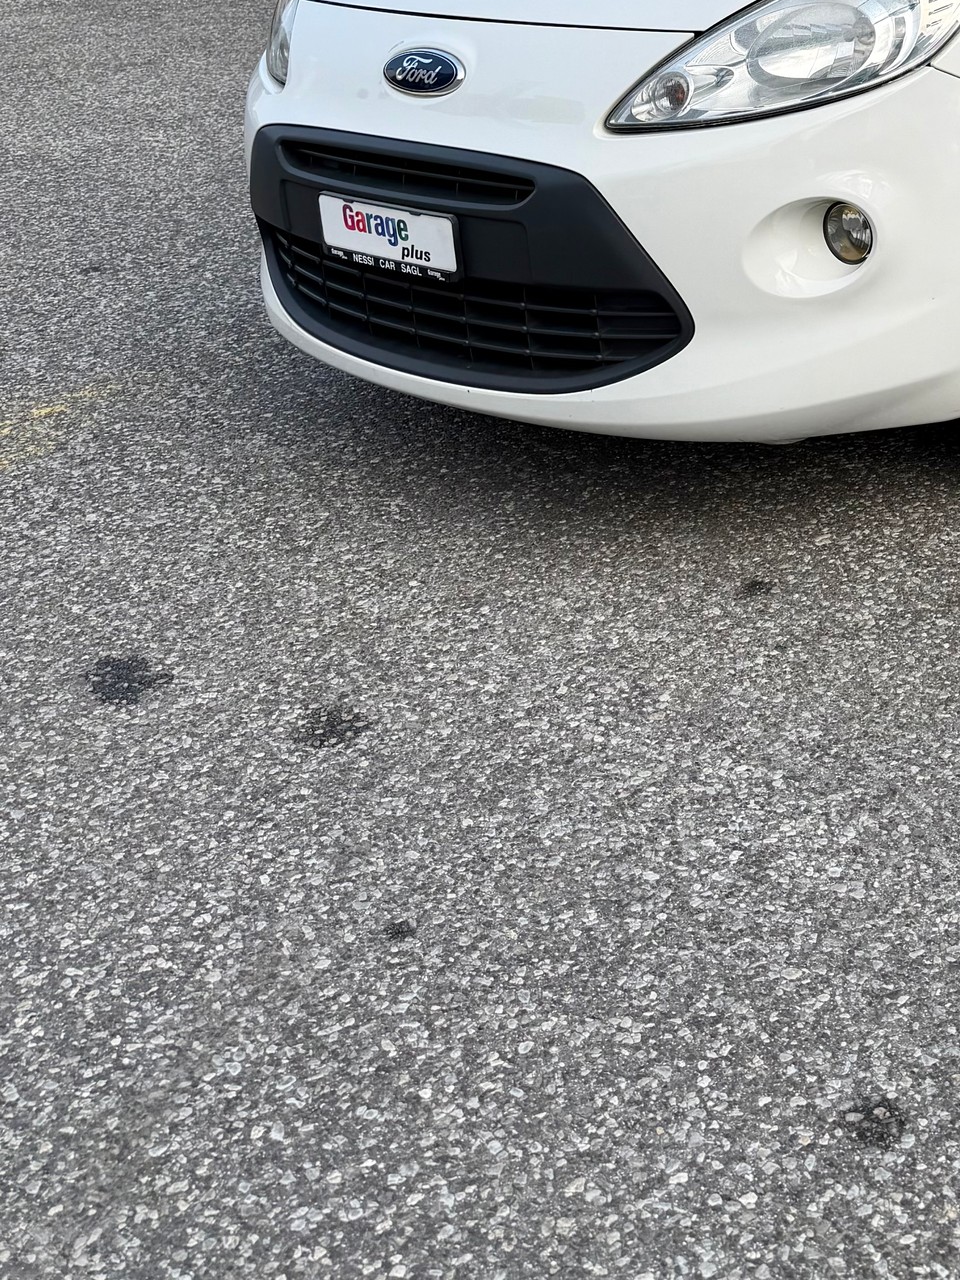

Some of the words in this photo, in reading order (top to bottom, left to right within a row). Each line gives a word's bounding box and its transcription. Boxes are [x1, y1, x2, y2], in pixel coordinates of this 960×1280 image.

[395, 55, 442, 85] Ford
[341, 203, 409, 247] Garage
[352, 253, 375, 266] NESSI
[379, 259, 396, 271] CAR
[401, 264, 423, 277] SAGL
[401, 245, 431, 262] plus
